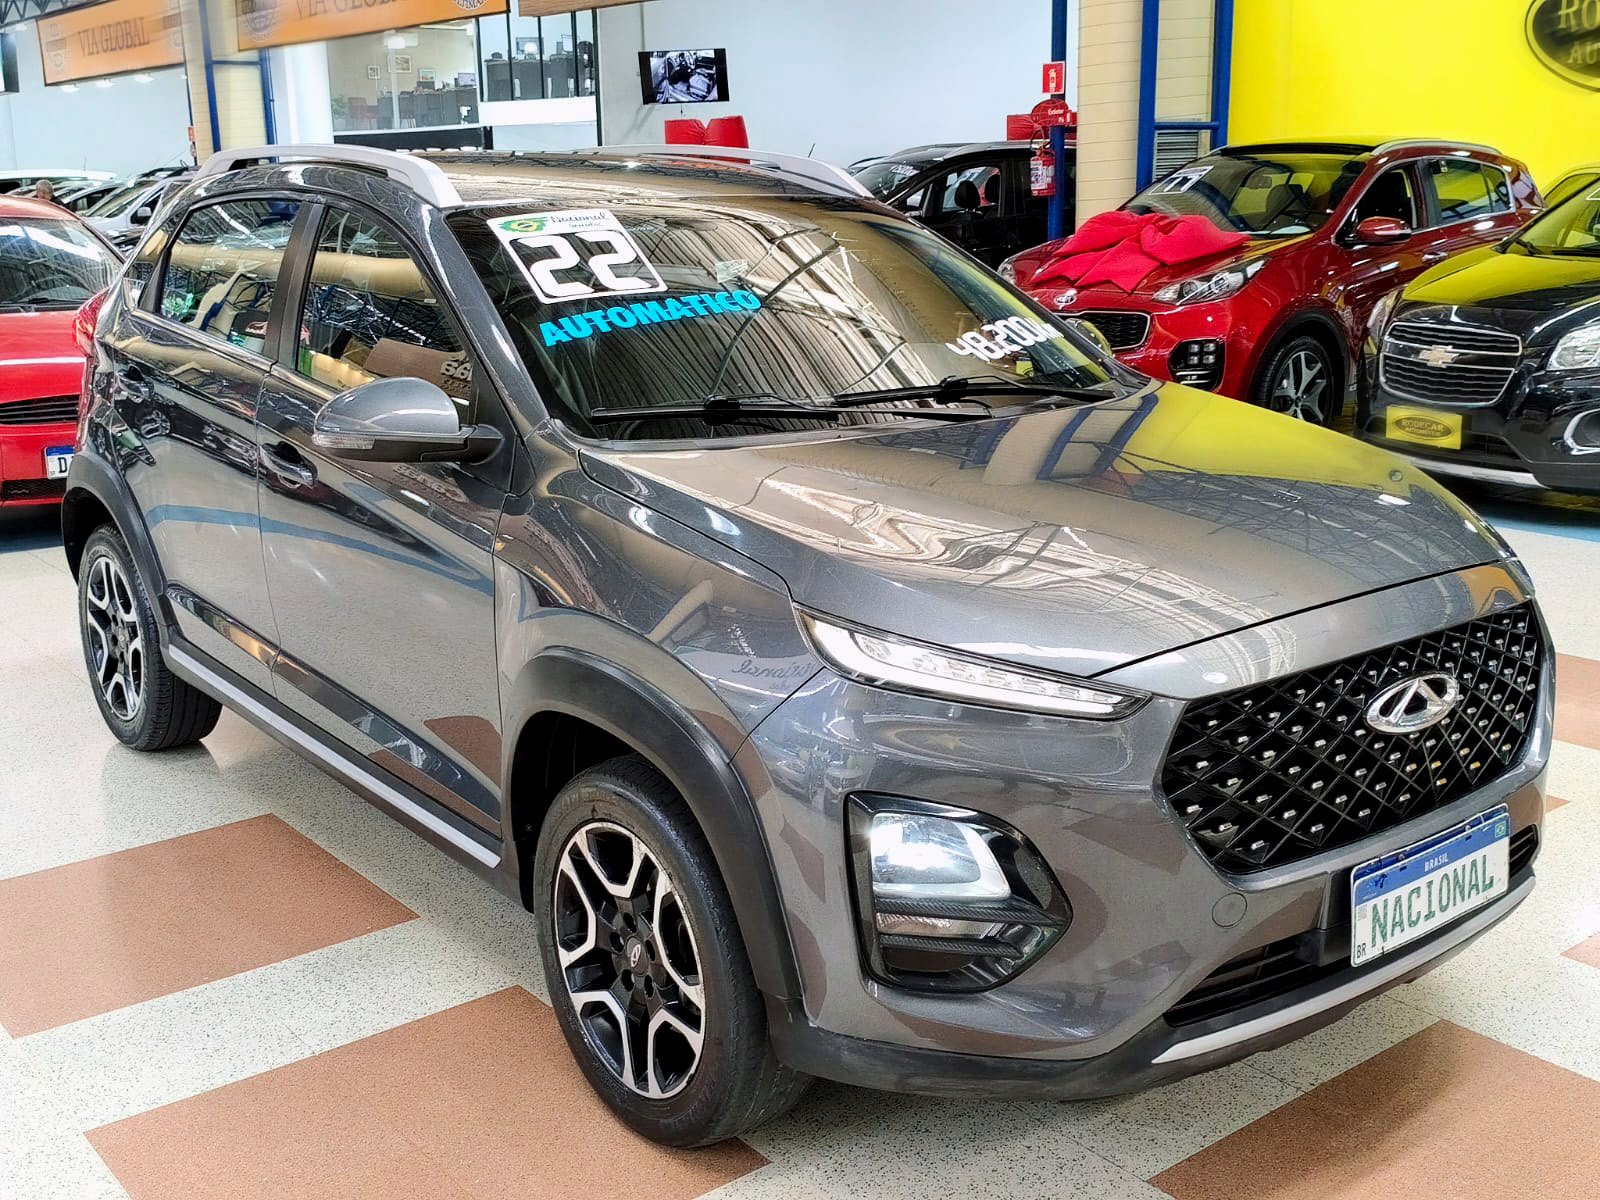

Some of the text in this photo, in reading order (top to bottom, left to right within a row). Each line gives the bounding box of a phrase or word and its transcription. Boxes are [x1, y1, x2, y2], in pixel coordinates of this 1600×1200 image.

[78, 28, 100, 57] VIA
[100, 17, 150, 52] GLOBAL
[516, 229, 653, 298] 22
[1424, 853, 1449, 872] BRASIL
[1371, 854, 1494, 948] NACIONAL
[1356, 942, 1367, 959] BR
